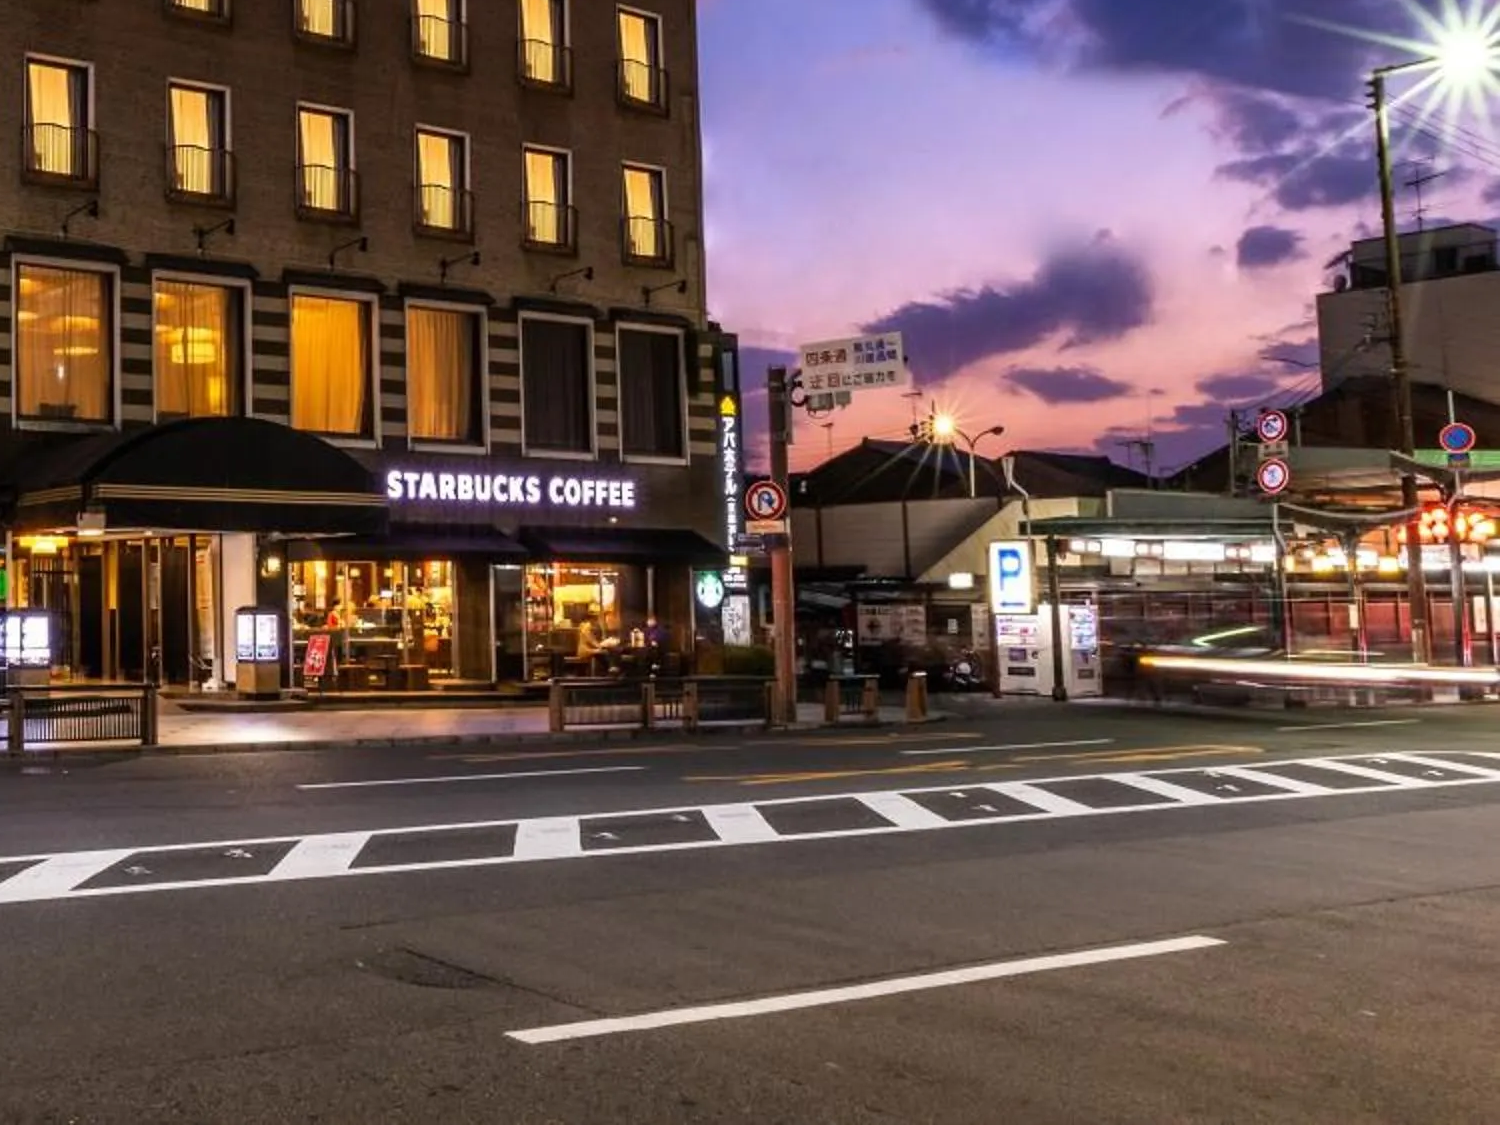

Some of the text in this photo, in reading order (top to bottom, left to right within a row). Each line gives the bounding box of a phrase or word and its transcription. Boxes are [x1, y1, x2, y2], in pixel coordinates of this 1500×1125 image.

[386, 470, 635, 507] STARBUCKS COFFEE
[998, 547, 1022, 592] P
